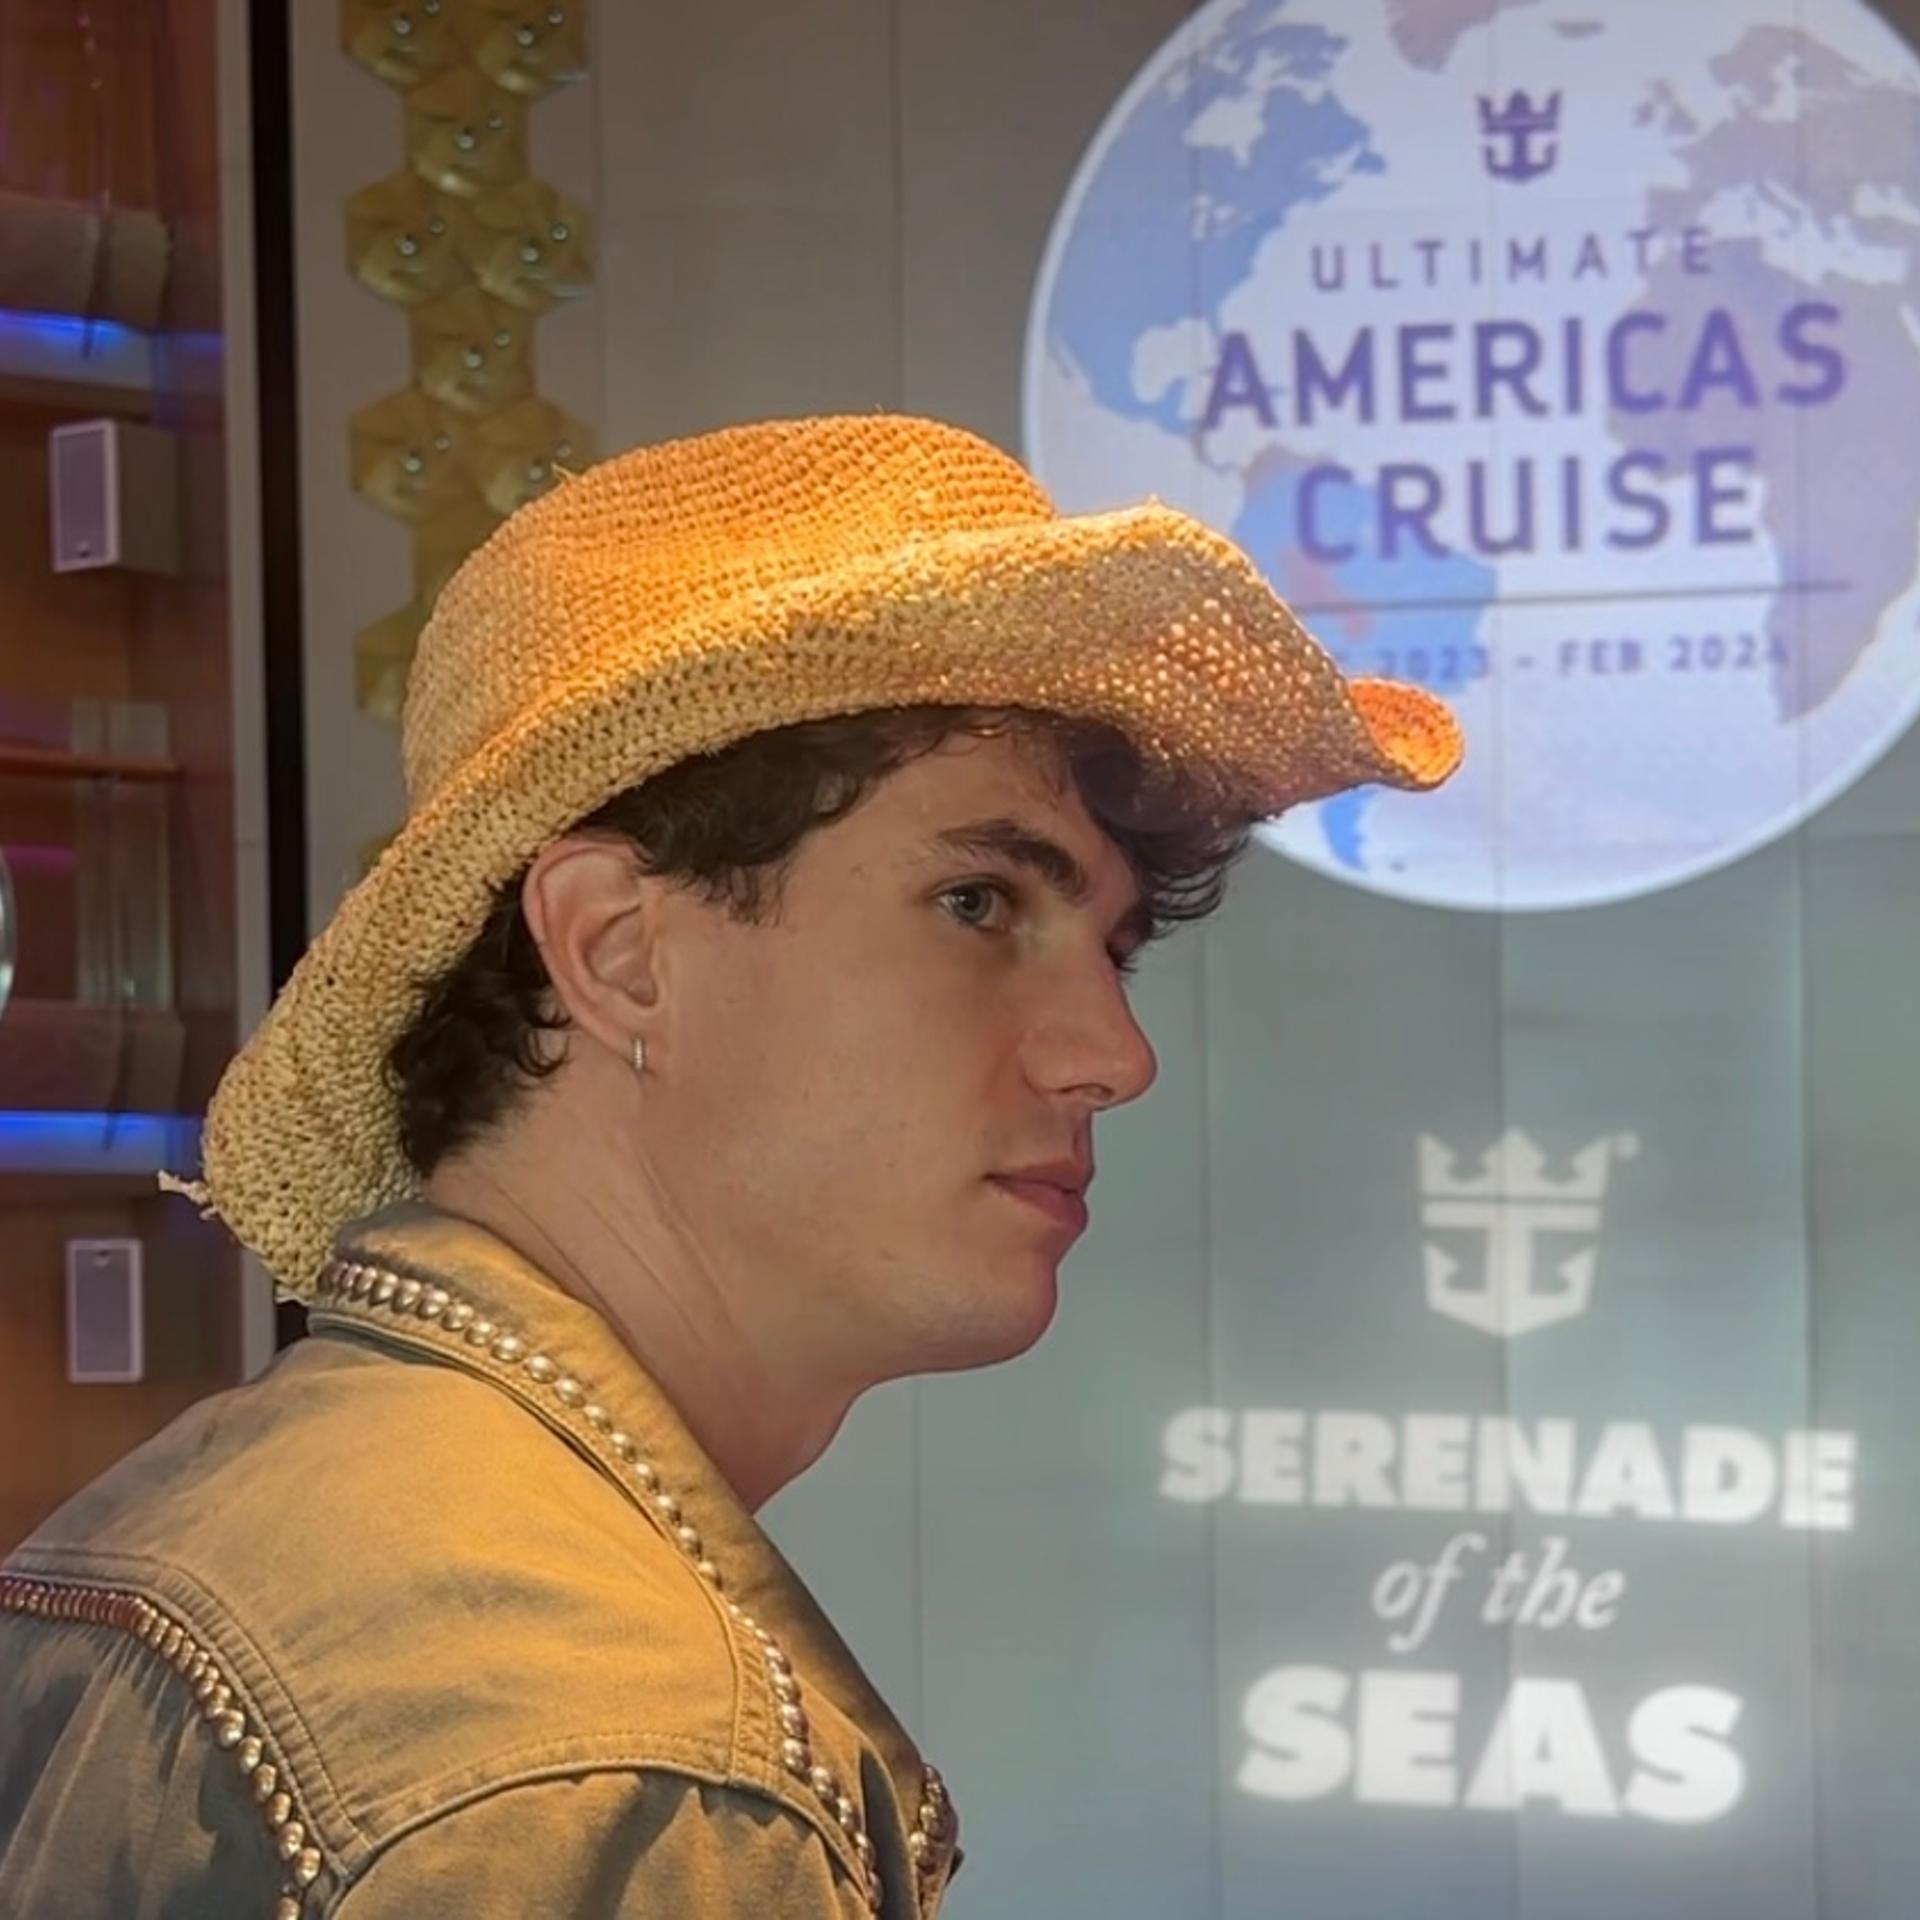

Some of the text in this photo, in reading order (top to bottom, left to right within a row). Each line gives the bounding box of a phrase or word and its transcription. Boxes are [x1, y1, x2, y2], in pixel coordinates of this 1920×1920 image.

[1310, 226, 1712, 291] ULTIMATE
[1202, 302, 1848, 429] AMERICAS
[1296, 446, 1757, 562] CRUISE
[1557, 638, 1643, 677] FEB
[1669, 633, 1789, 672] 2024
[1159, 1406, 1858, 1530] SERENADE
[1371, 1532, 1625, 1652] of the
[1236, 1664, 1746, 1823] SEAS
